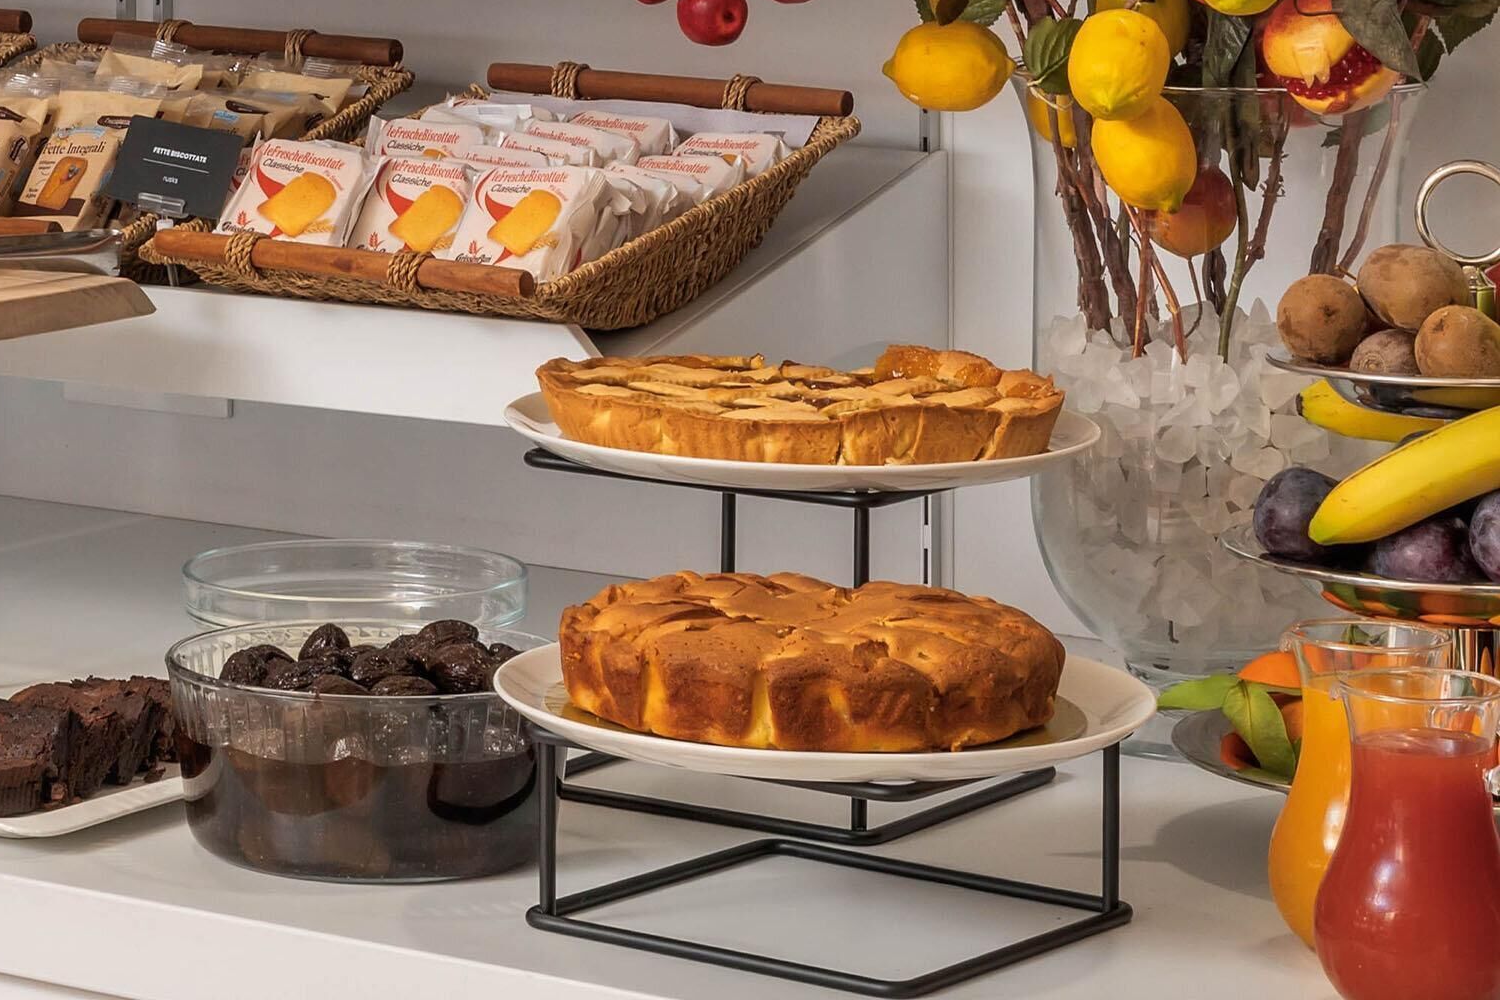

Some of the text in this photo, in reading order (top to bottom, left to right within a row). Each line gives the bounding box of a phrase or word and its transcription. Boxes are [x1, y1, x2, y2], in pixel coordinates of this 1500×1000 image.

[386, 125, 461, 144] leFrescheBiscottate
[67, 141, 107, 156] Integrali
[387, 140, 425, 151] Classiche
[153, 146, 208, 164] FETTE BISCOTTATE
[263, 144, 347, 172] leFrescheBiscottate
[262, 158, 305, 174] Classiche
[391, 173, 432, 187] Classiche
[491, 168, 570, 184] leFrescheBiscottate
[490, 183, 532, 194] Classiche
